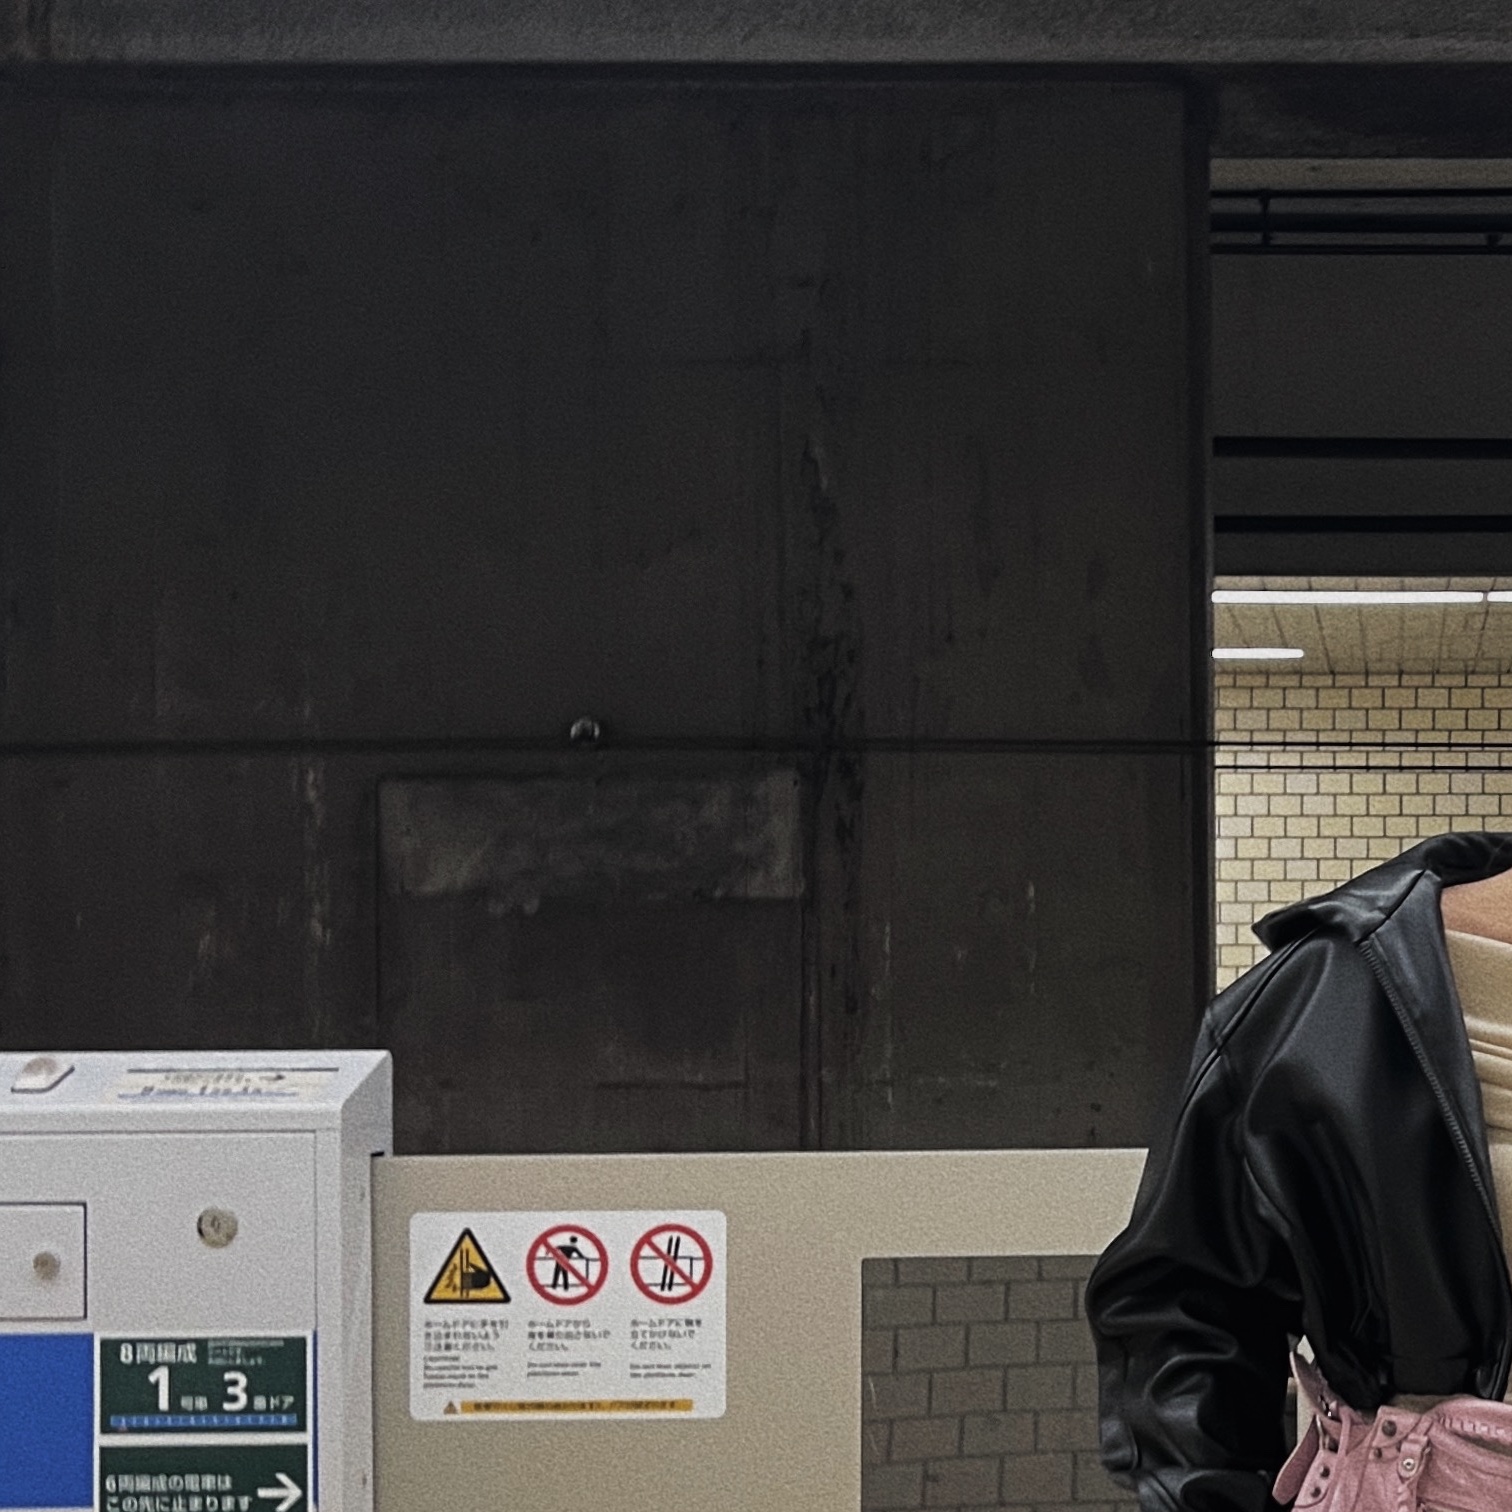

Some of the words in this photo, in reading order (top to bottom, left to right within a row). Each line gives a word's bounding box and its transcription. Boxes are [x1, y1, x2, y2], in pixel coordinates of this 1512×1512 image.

[119, 1342, 198, 1365] 8両編成
[148, 1365, 170, 1412] 1
[222, 1370, 248, 1412] 3
